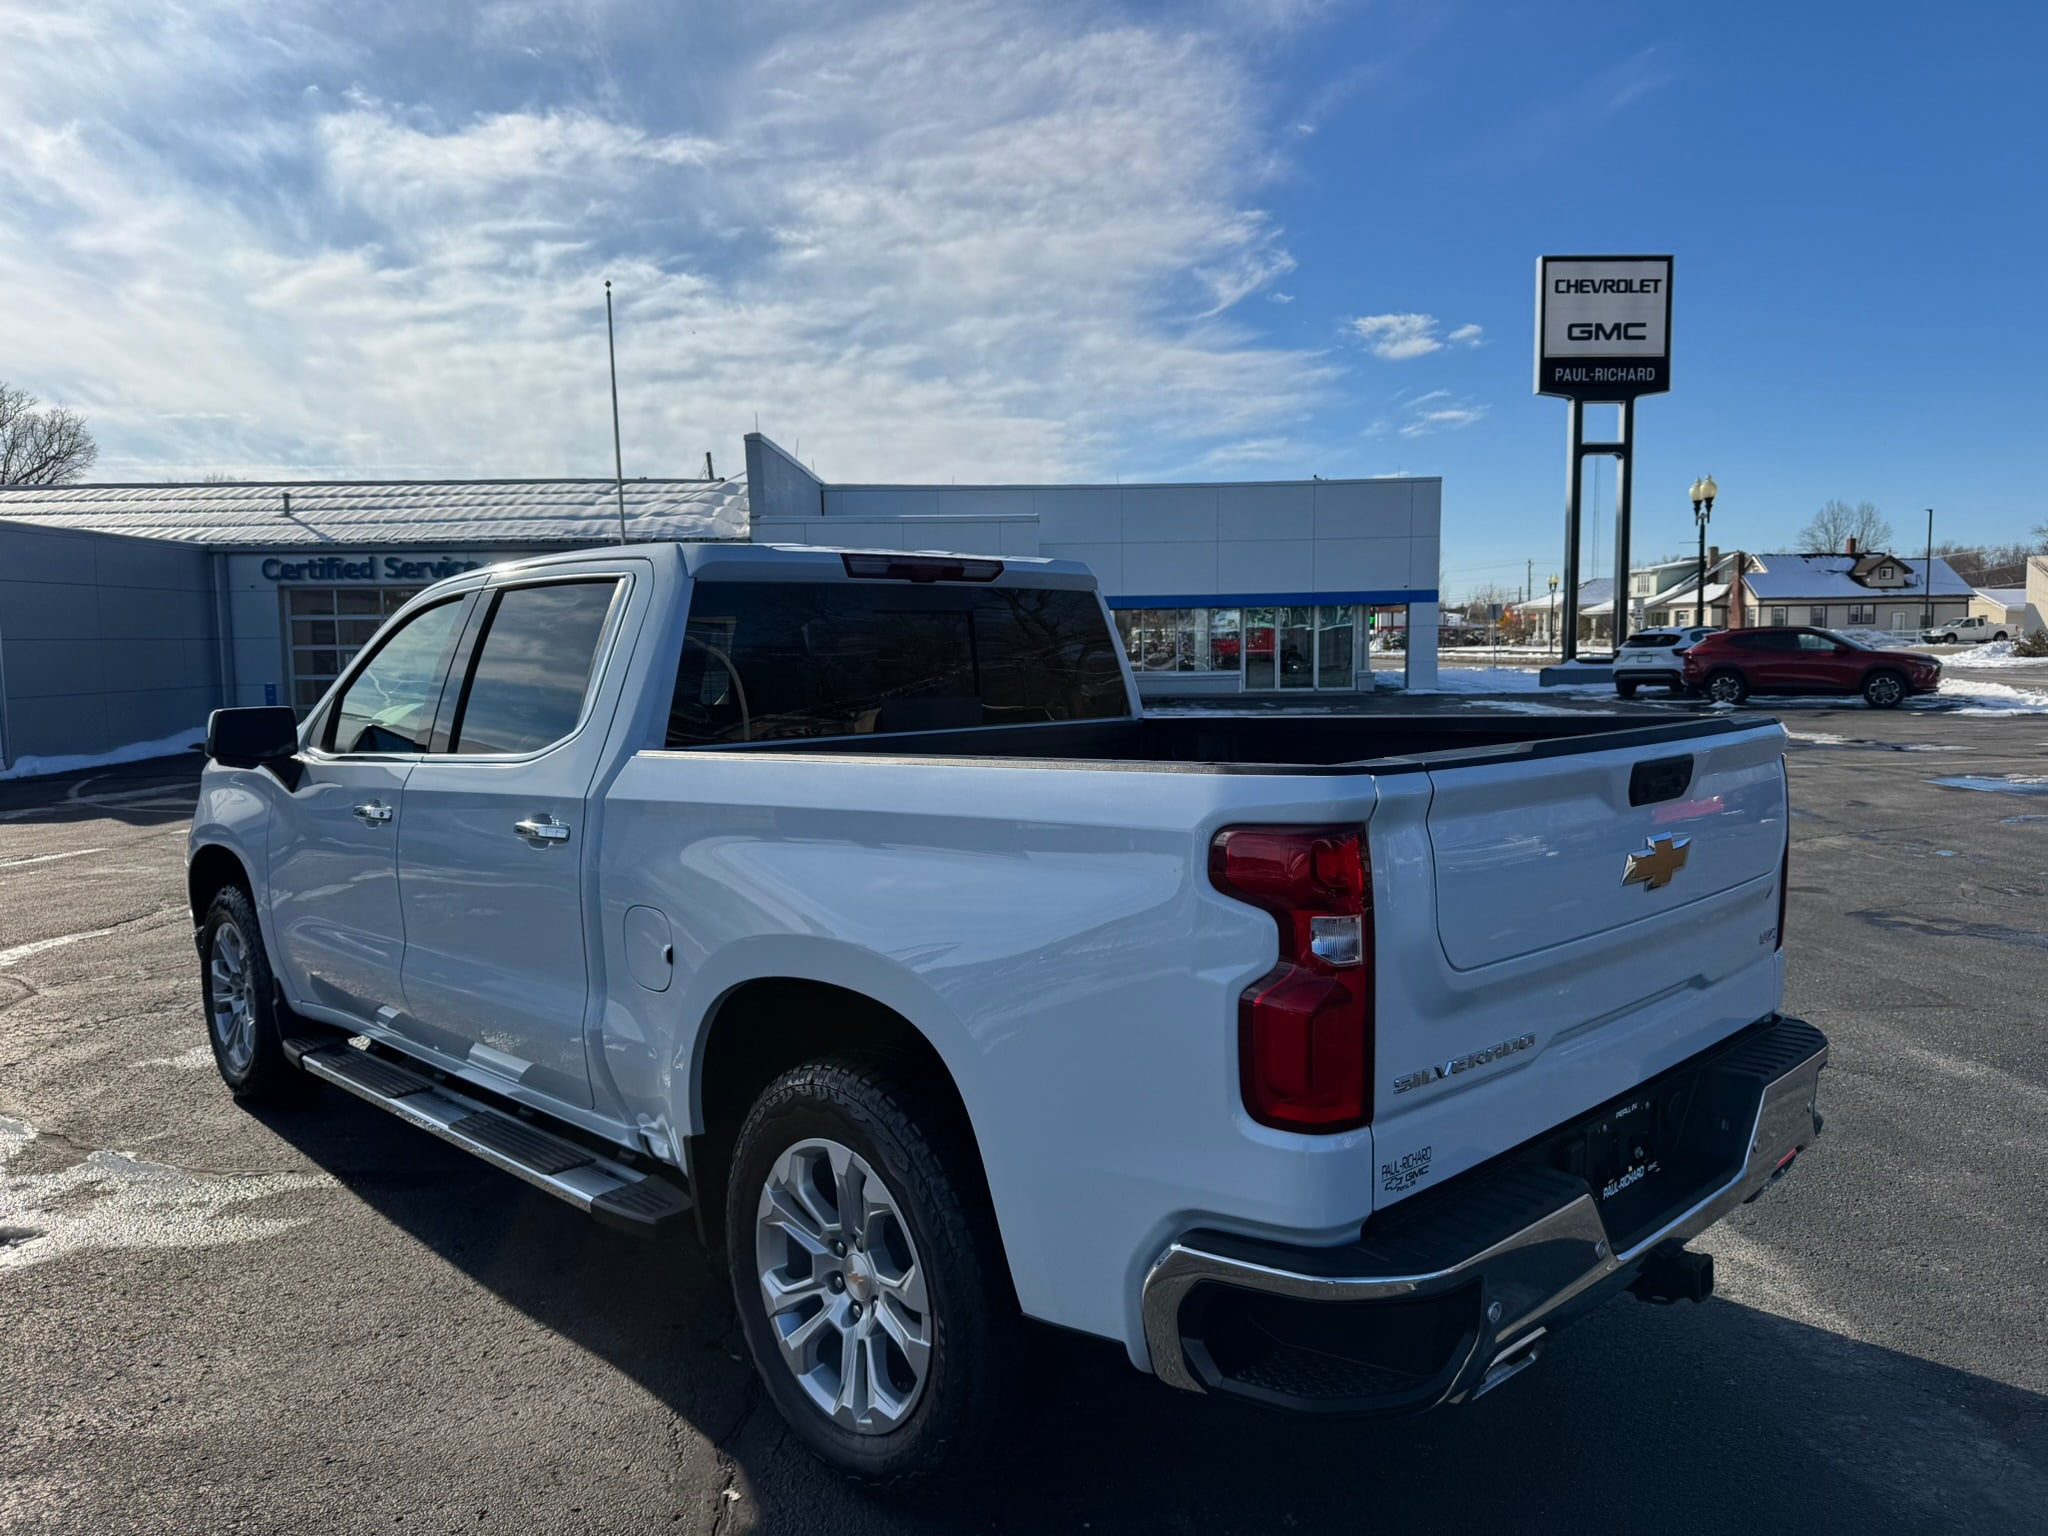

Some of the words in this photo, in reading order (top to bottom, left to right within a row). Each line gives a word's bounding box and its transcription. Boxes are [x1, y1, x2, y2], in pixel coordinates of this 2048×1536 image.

[1554, 279, 1662, 294] CHEVROLET
[1567, 322, 1647, 341] GMC
[1555, 367, 1656, 382] PAUL-RICHARD
[261, 556, 375, 581] Certified
[1393, 1032, 1537, 1095] SILVERADO
[1381, 1146, 1432, 1179] PAUL-RICHARD
[1405, 1164, 1430, 1182] GMC
[1602, 1165, 1646, 1200] PAUL-RICHARD
